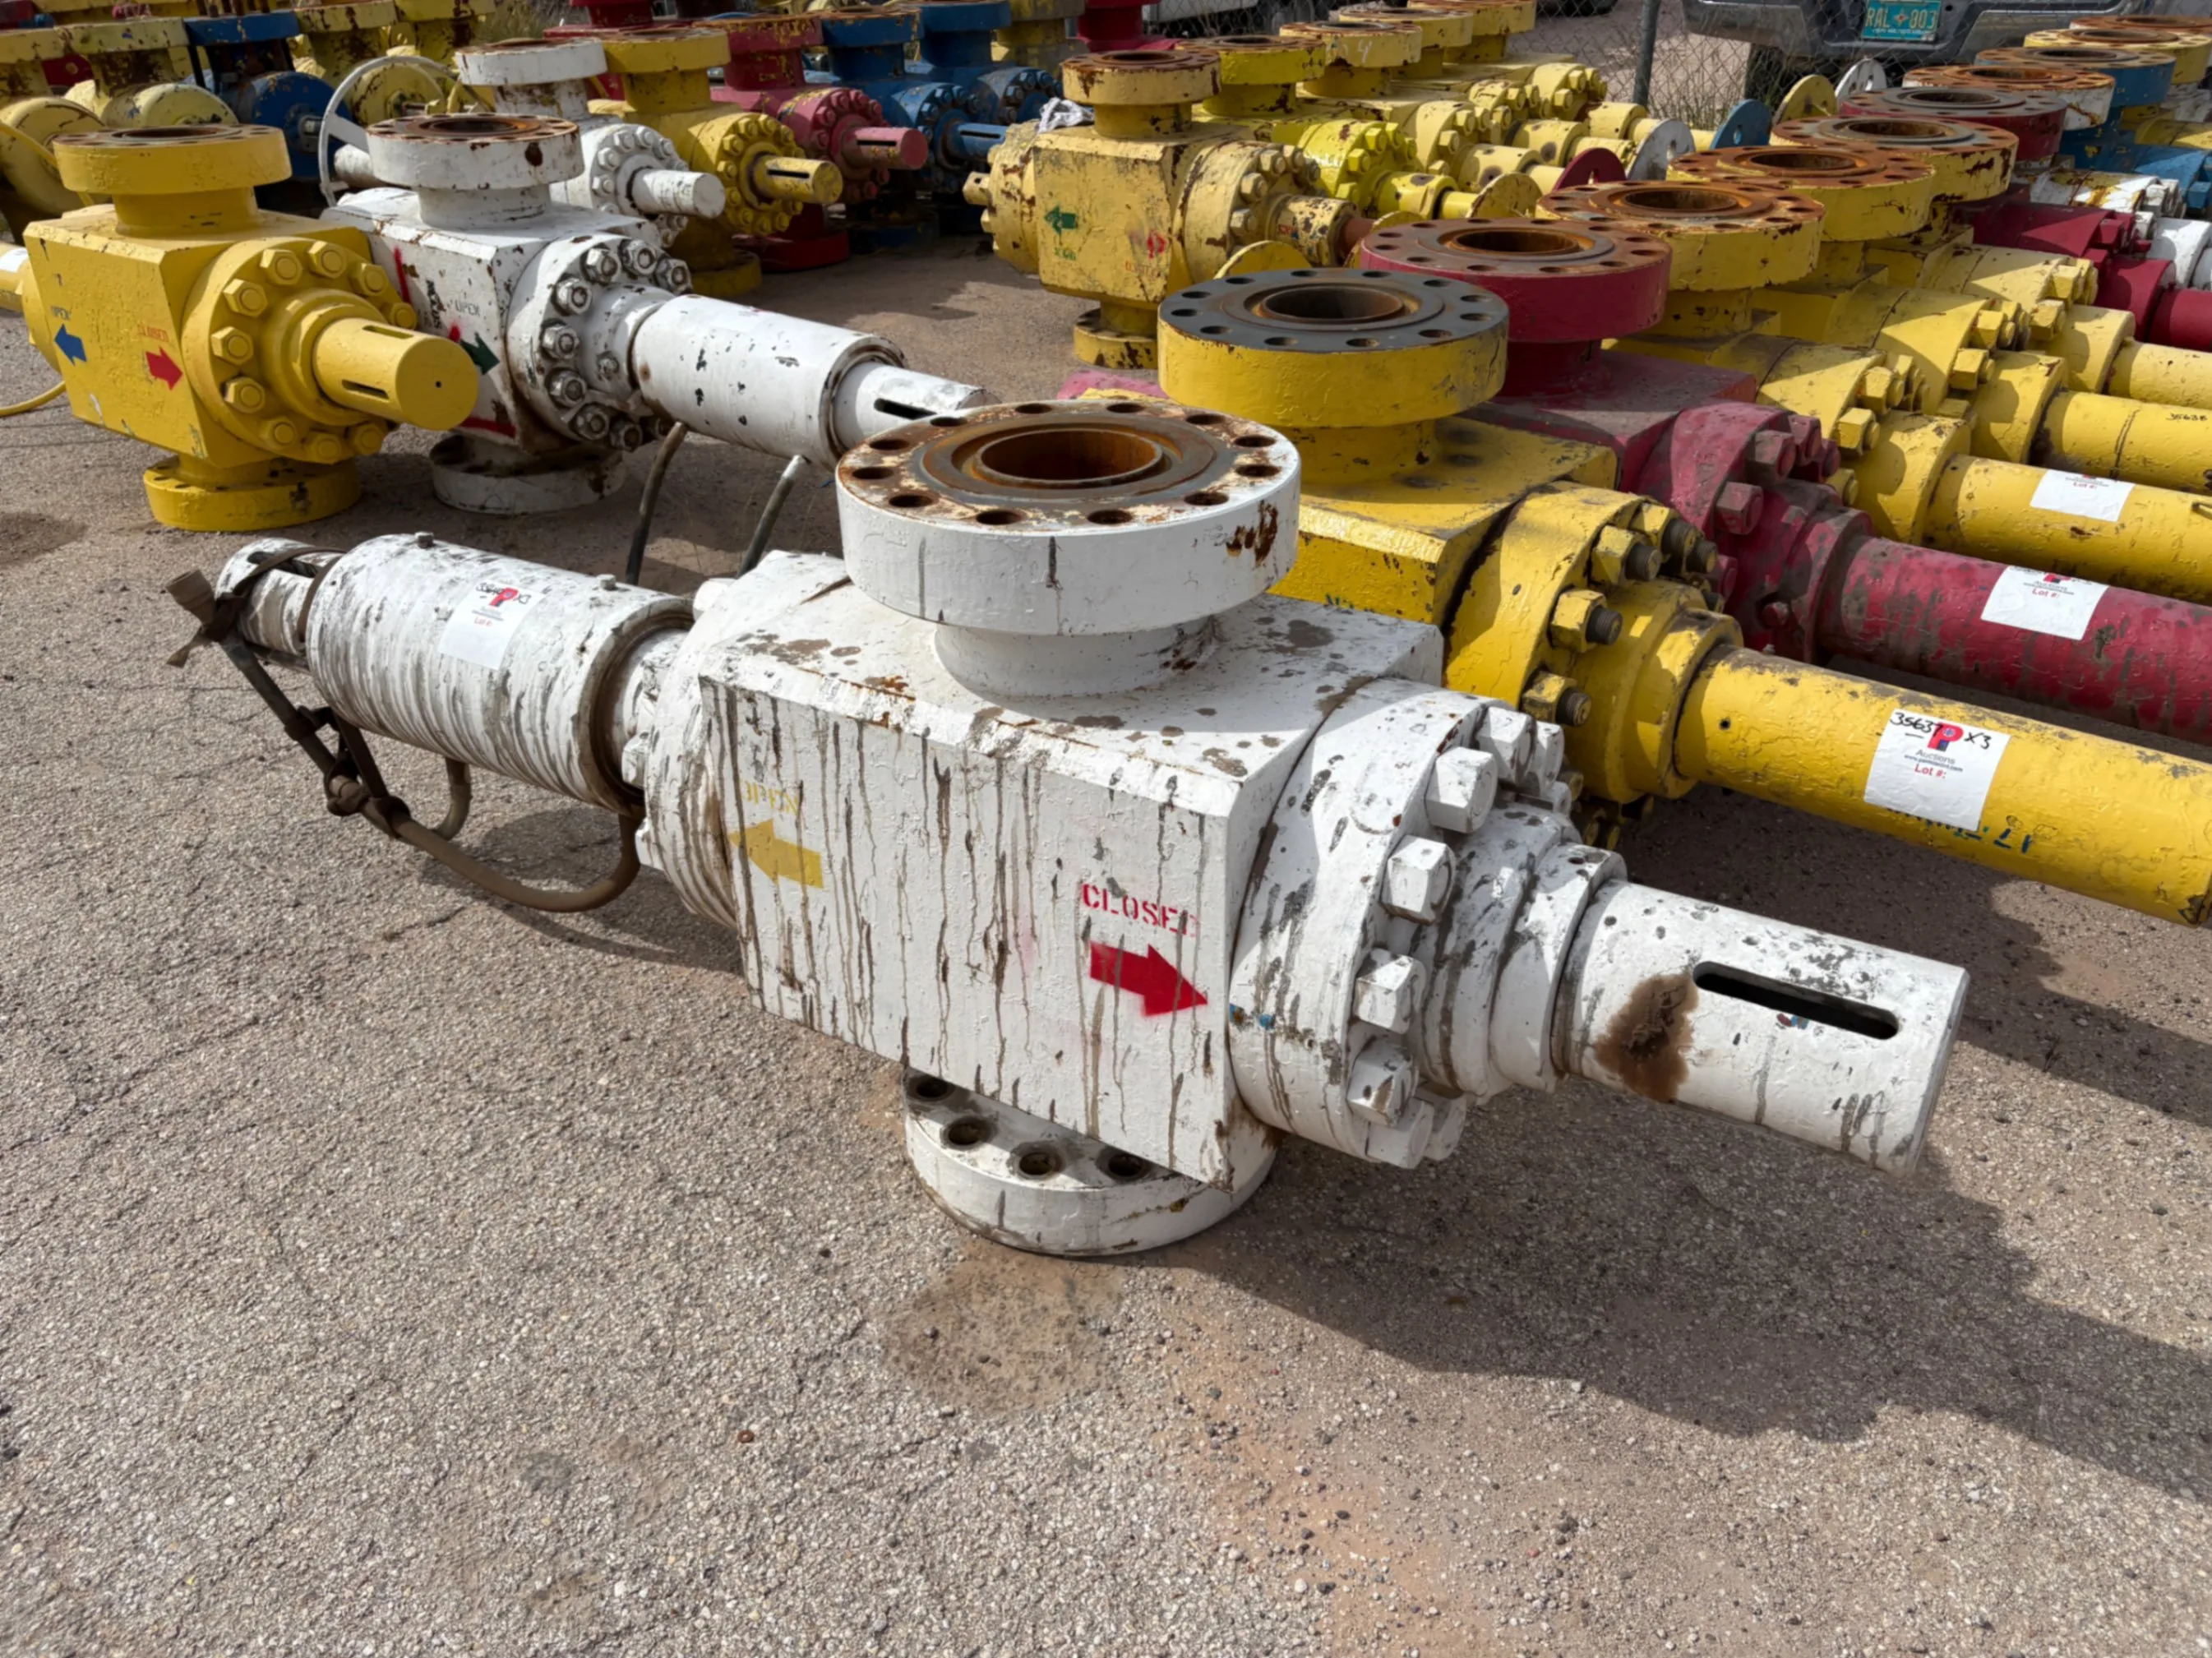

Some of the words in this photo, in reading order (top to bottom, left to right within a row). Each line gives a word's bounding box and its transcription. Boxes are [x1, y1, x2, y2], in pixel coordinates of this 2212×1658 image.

[2032, 587, 2048, 598] Lot
[1890, 712, 1943, 737] 35637
[1915, 749, 1956, 764] Auctions
[1914, 764, 1933, 776] Lot
